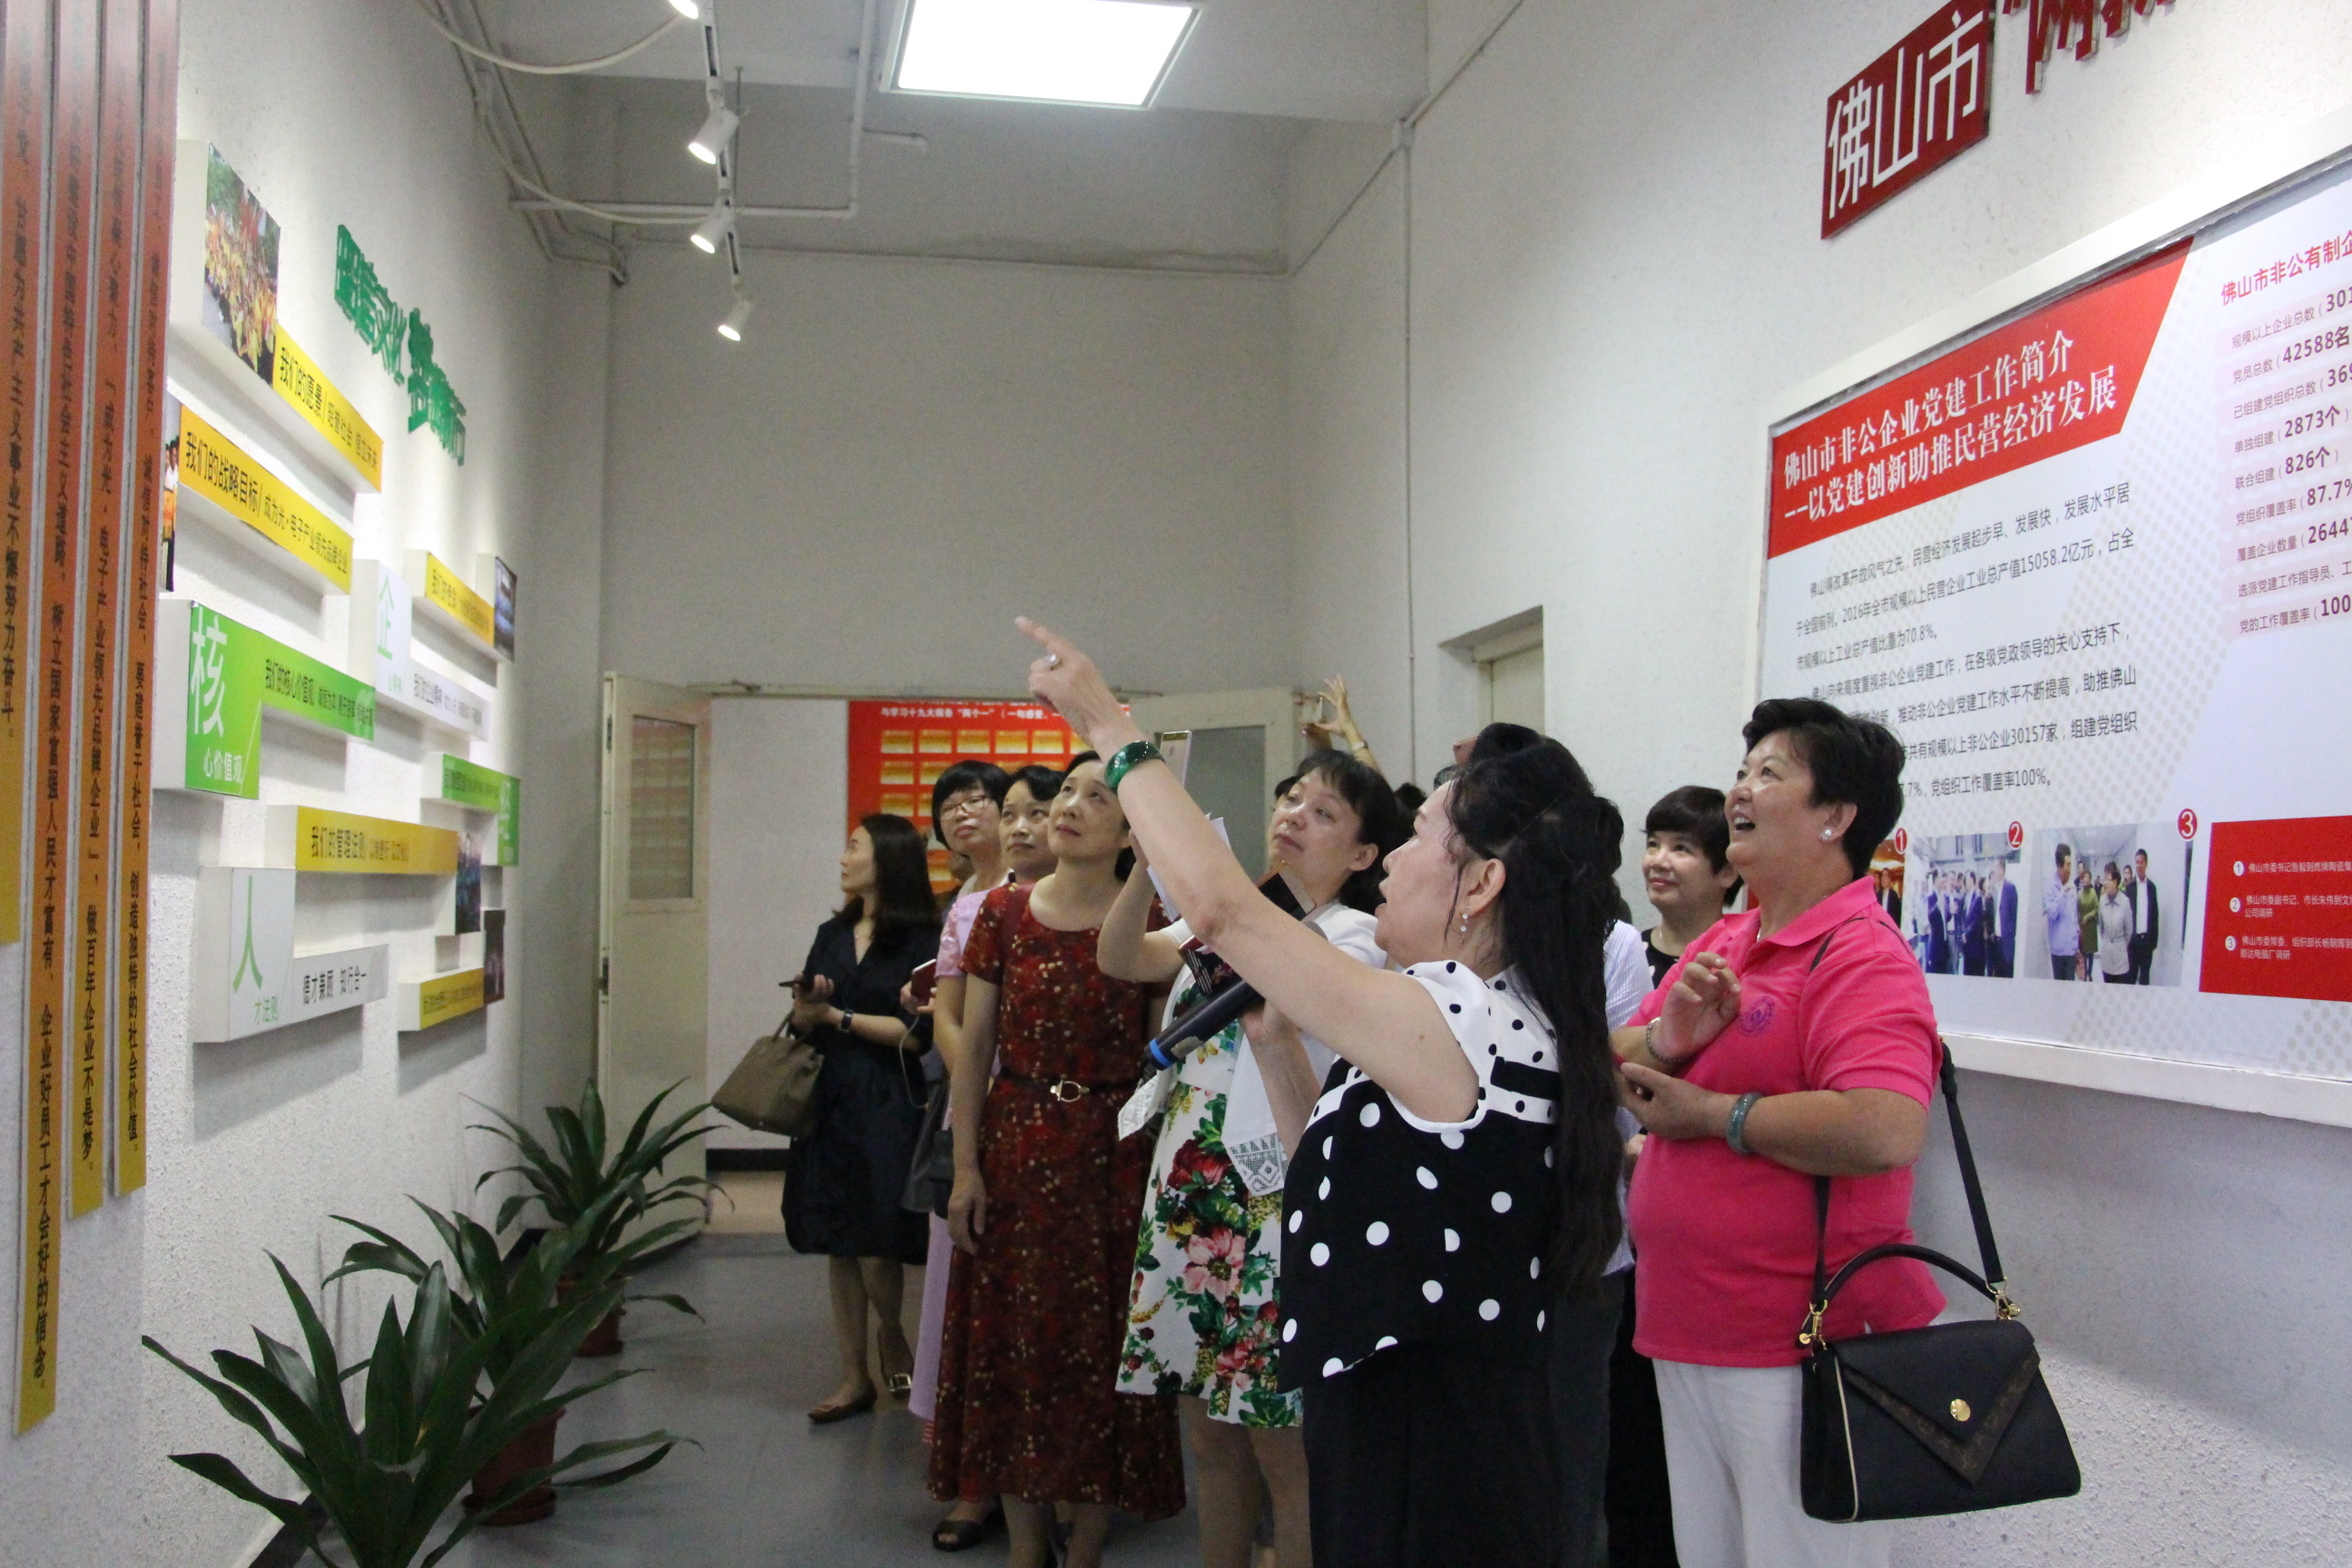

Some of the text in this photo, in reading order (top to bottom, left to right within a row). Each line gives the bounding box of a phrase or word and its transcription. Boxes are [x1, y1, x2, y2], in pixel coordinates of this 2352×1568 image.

[1828, 9, 1984, 219] 佛山市
[1784, 329, 2073, 489] 佛山市非公企业党建工作简介
[191, 606, 228, 738] 核
[204, 748, 242, 784] 心价值观
[232, 876, 263, 994] 人
